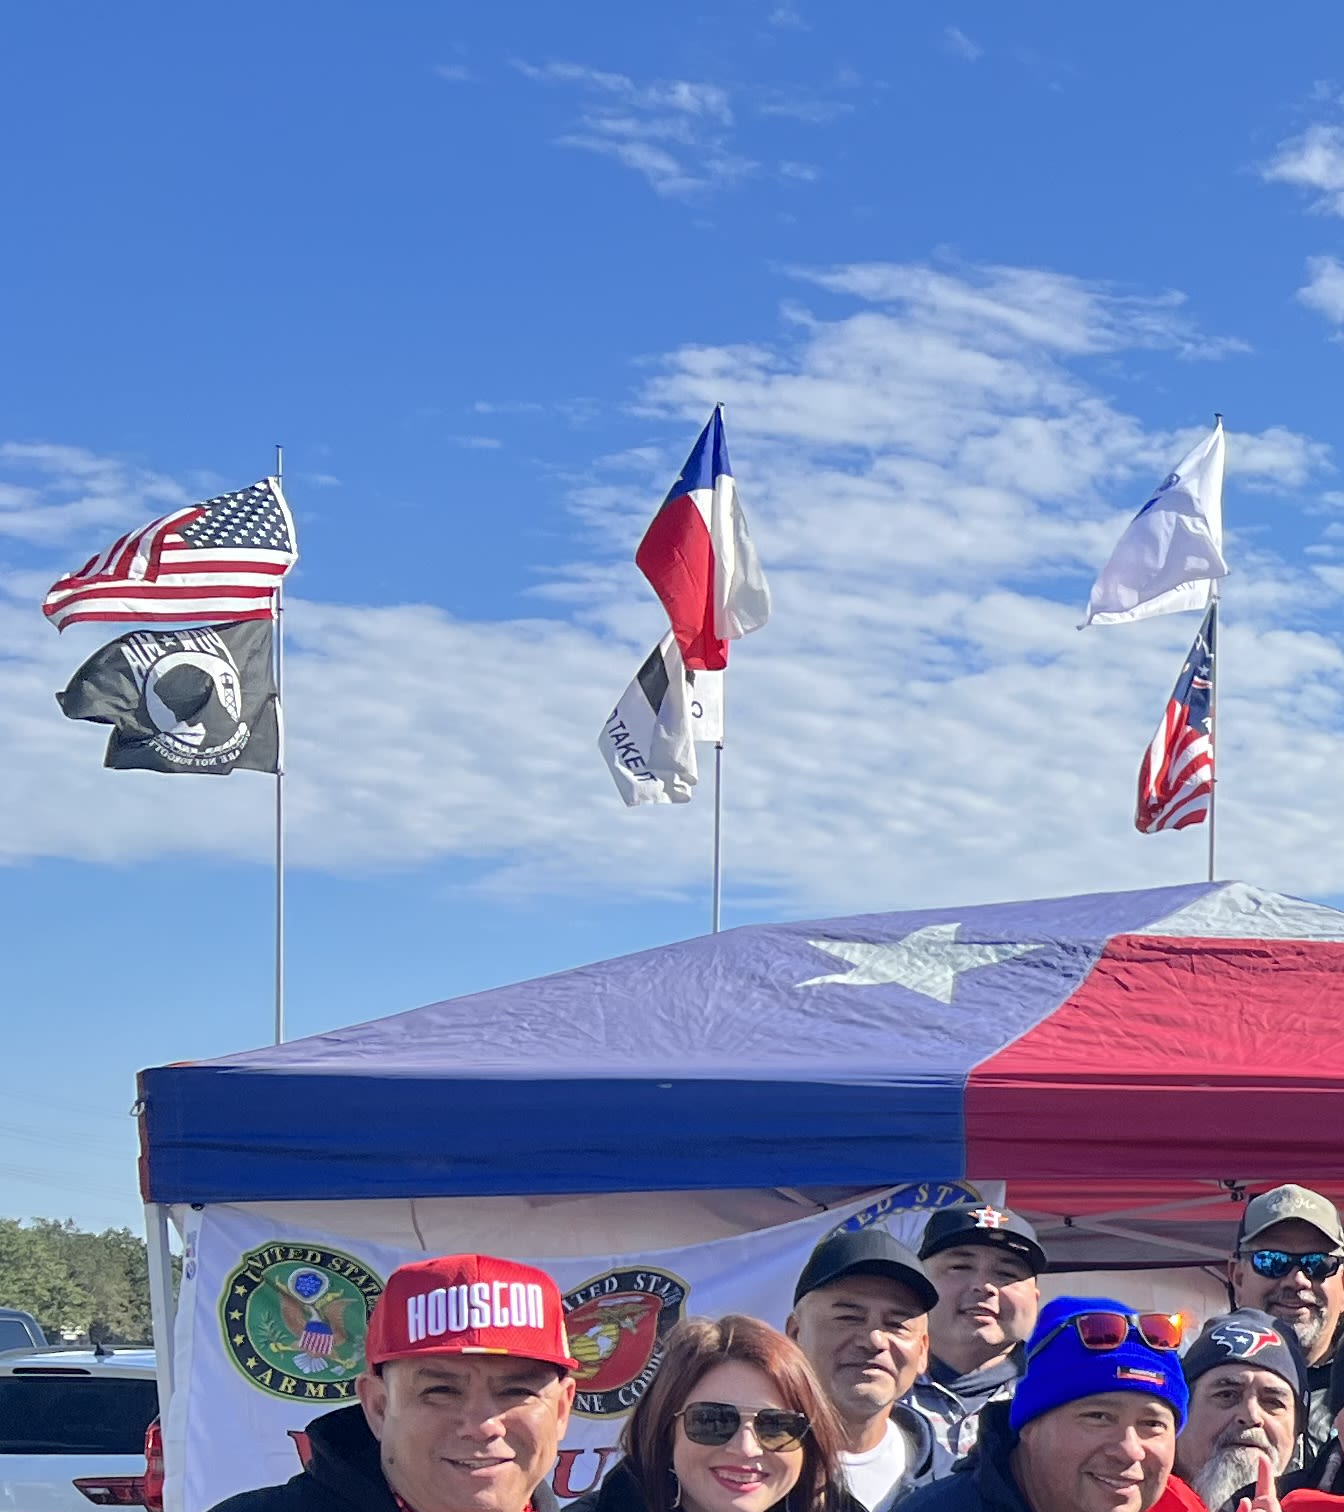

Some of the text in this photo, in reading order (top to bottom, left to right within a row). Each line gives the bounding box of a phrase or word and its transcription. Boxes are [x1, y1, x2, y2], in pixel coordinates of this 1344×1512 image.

[608, 721, 647, 770] TAKE
[244, 1246, 321, 1282] UNITED
[257, 1368, 349, 1398] ARMY
